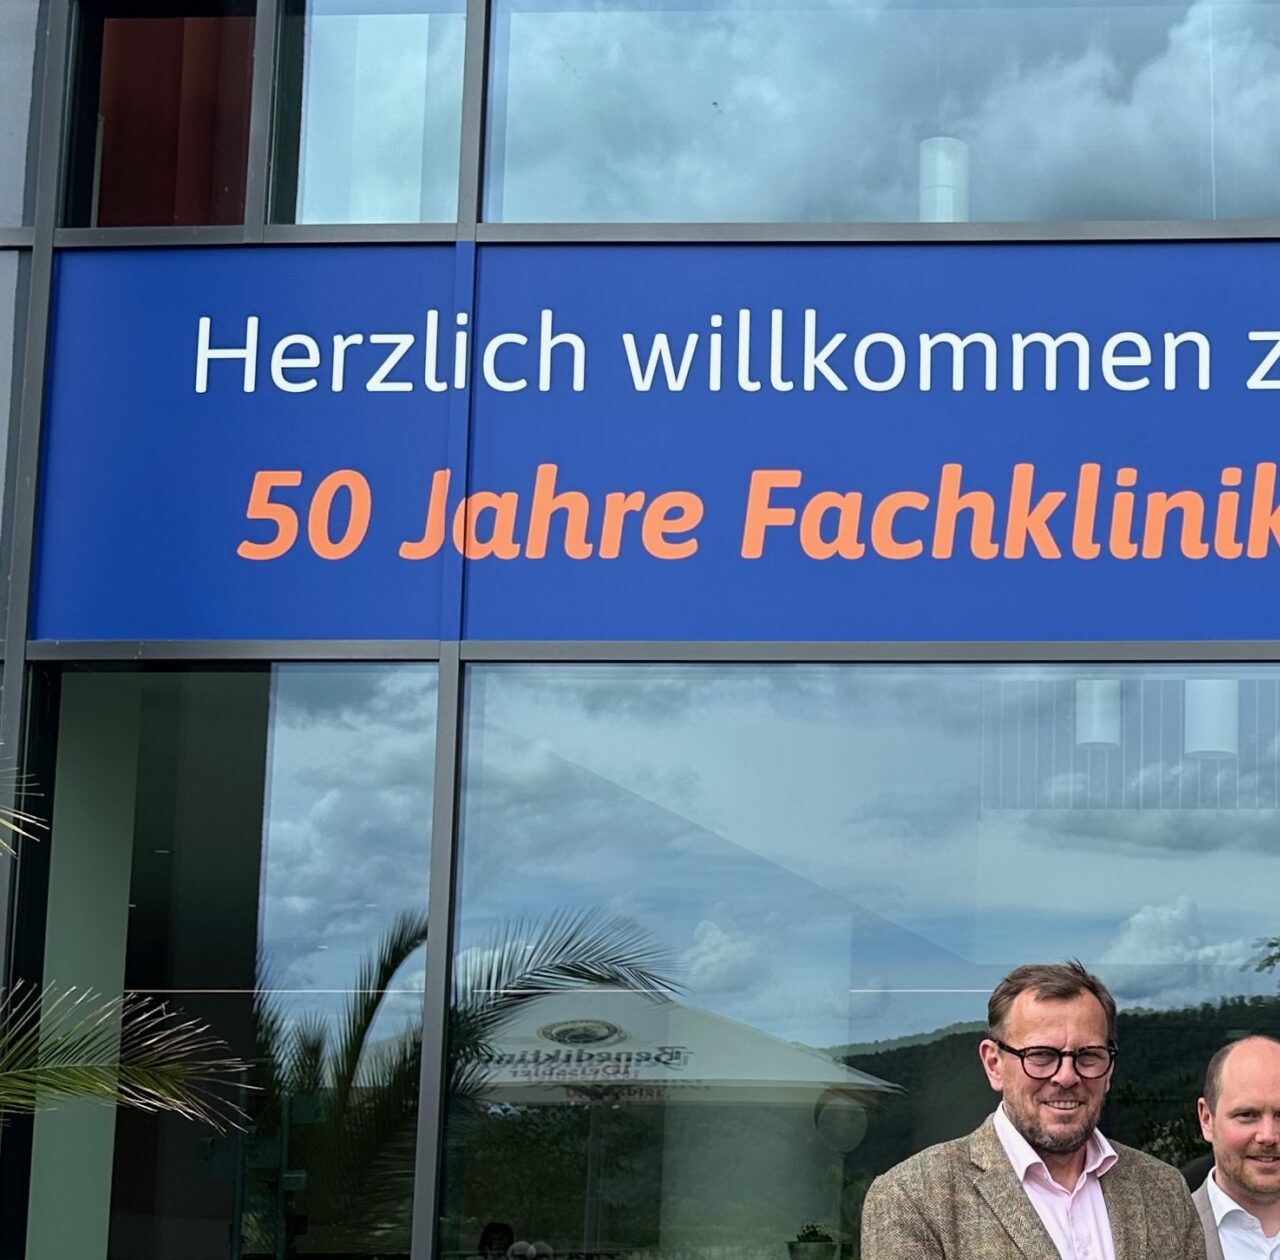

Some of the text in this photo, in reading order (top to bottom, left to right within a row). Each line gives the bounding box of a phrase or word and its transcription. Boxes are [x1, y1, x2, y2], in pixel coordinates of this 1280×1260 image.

[194, 308, 586, 394] Herzlich
[621, 307, 1211, 393] willkommen
[235, 467, 373, 562] 50
[397, 462, 705, 562] Jahre
